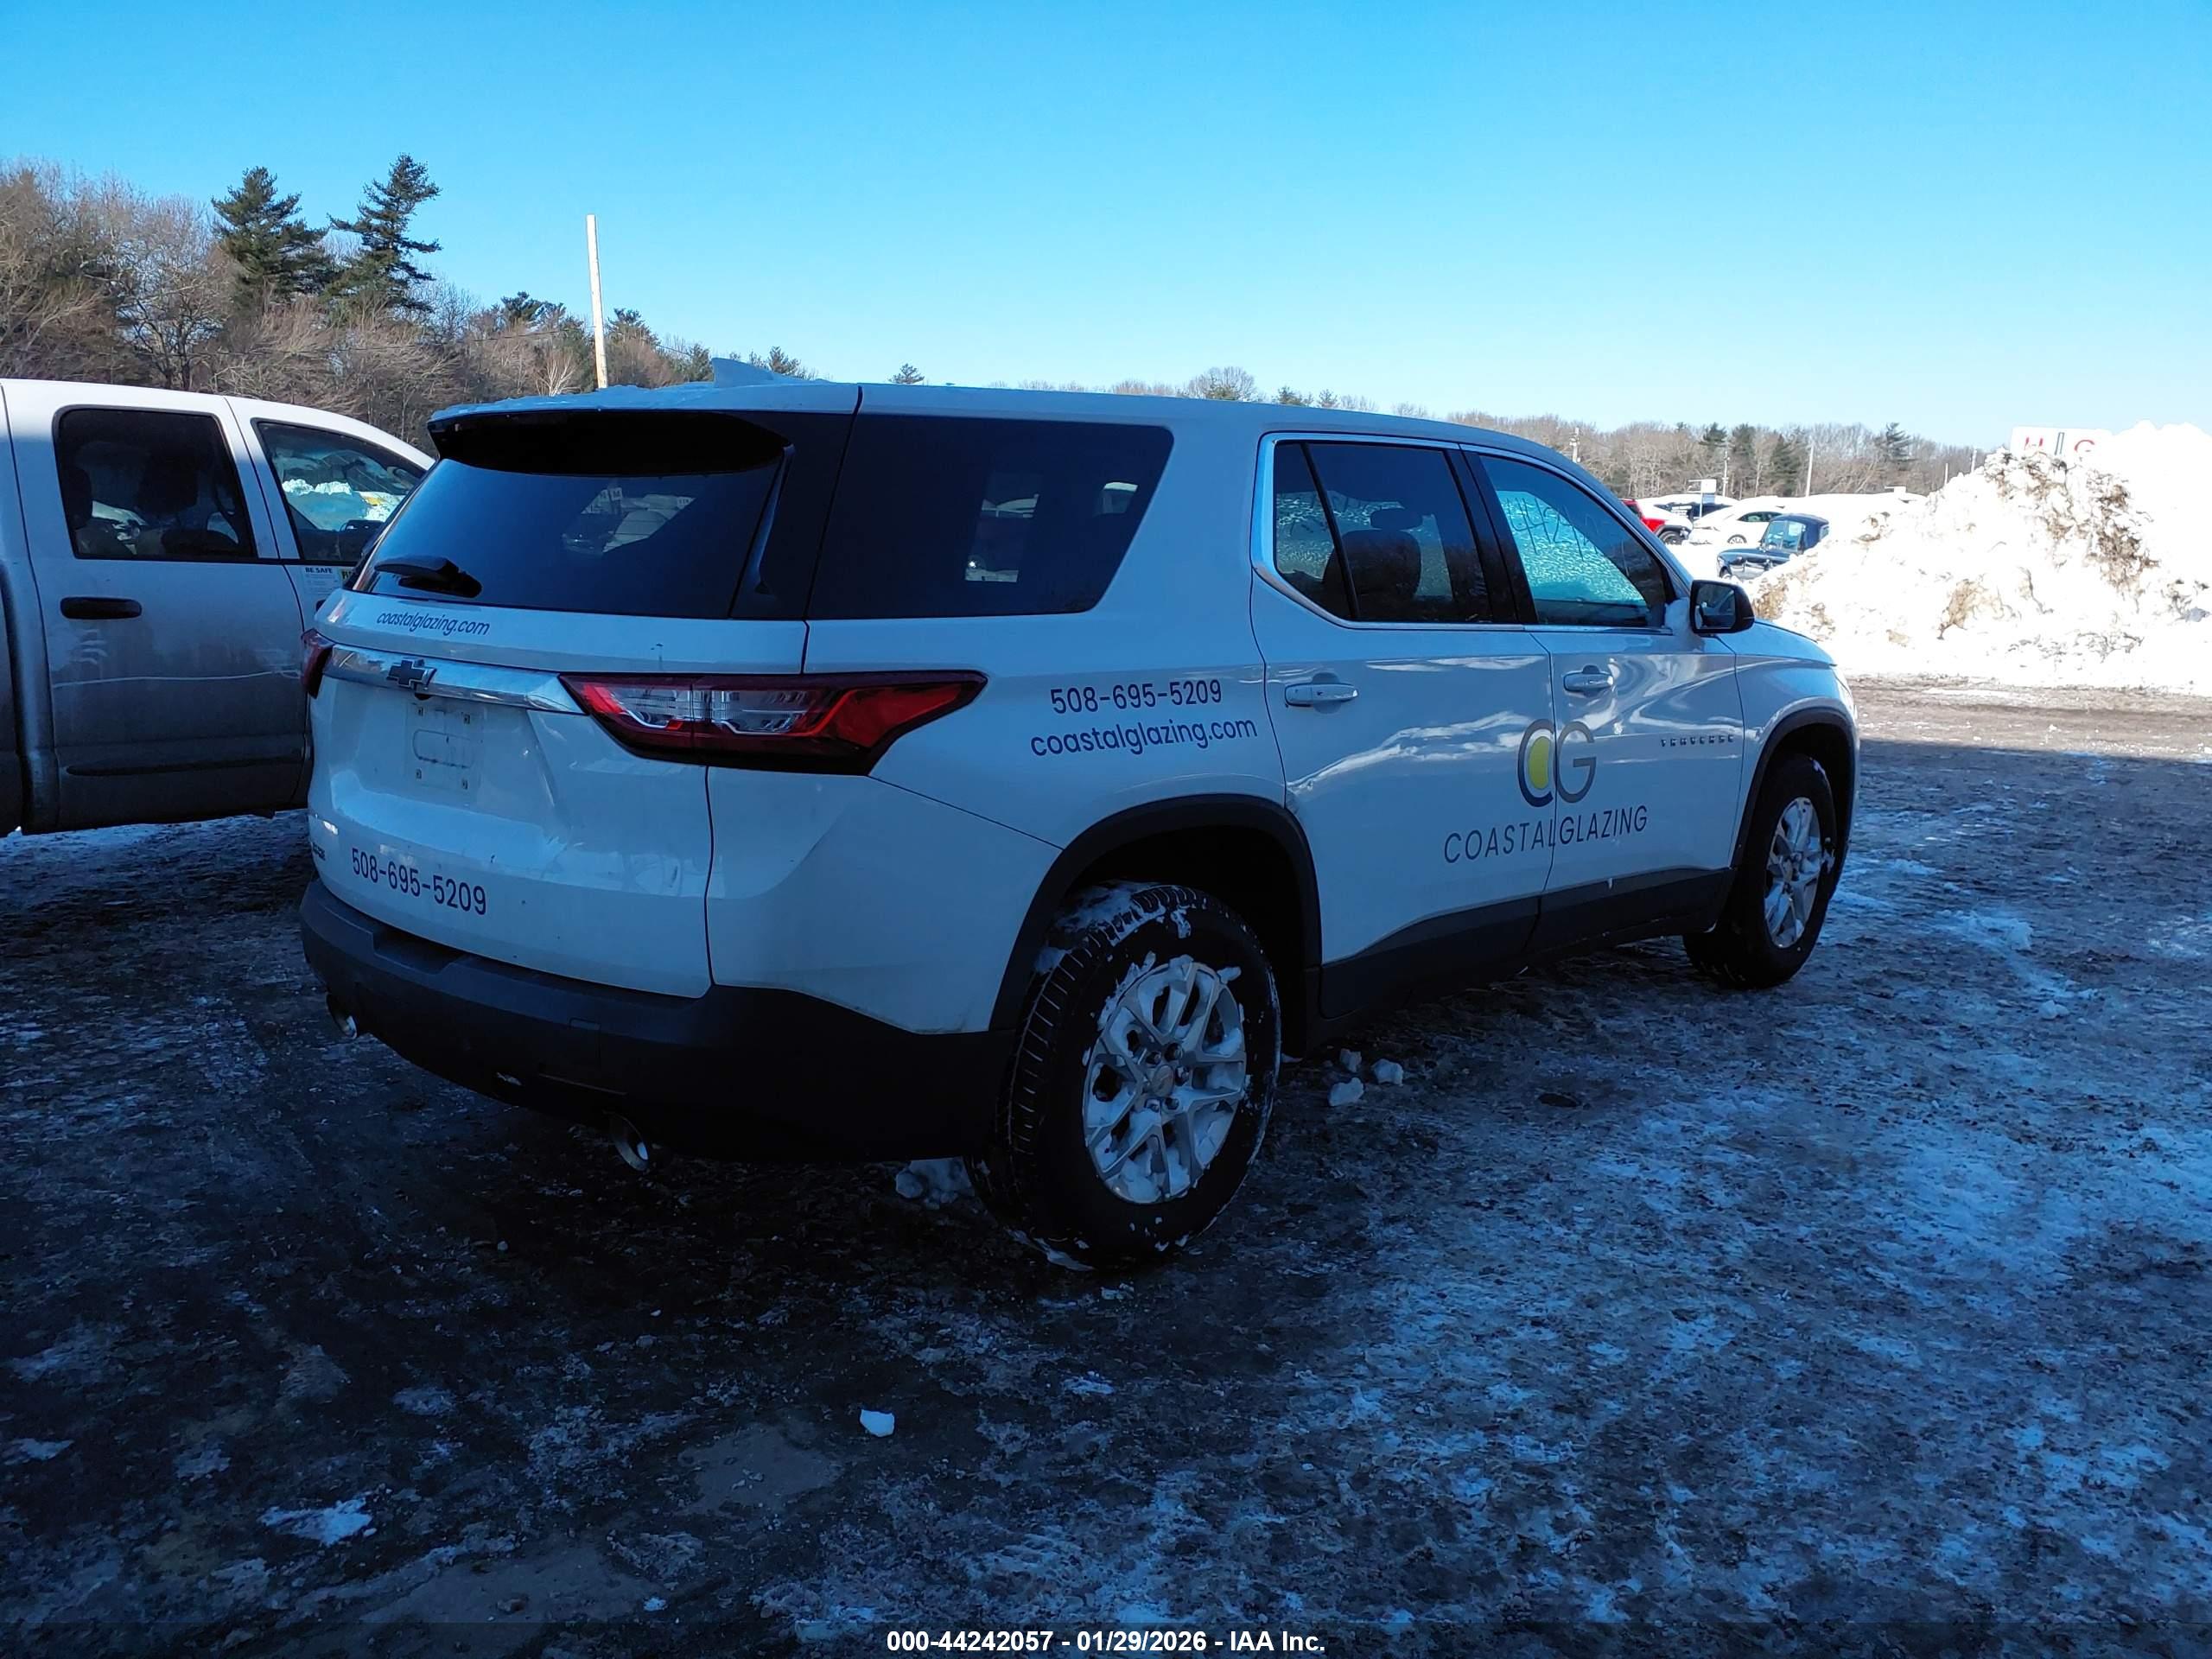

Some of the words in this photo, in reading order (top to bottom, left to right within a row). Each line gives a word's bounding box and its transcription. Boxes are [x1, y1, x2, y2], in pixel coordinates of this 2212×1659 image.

[376, 610, 491, 637] coastalglazing.com
[1050, 678, 1223, 715] 508-695-5209
[1030, 718, 1258, 756] coastalglazing.com
[1444, 804, 1648, 863] COASTALGLAZING
[352, 849, 487, 916] 508-695-5209
